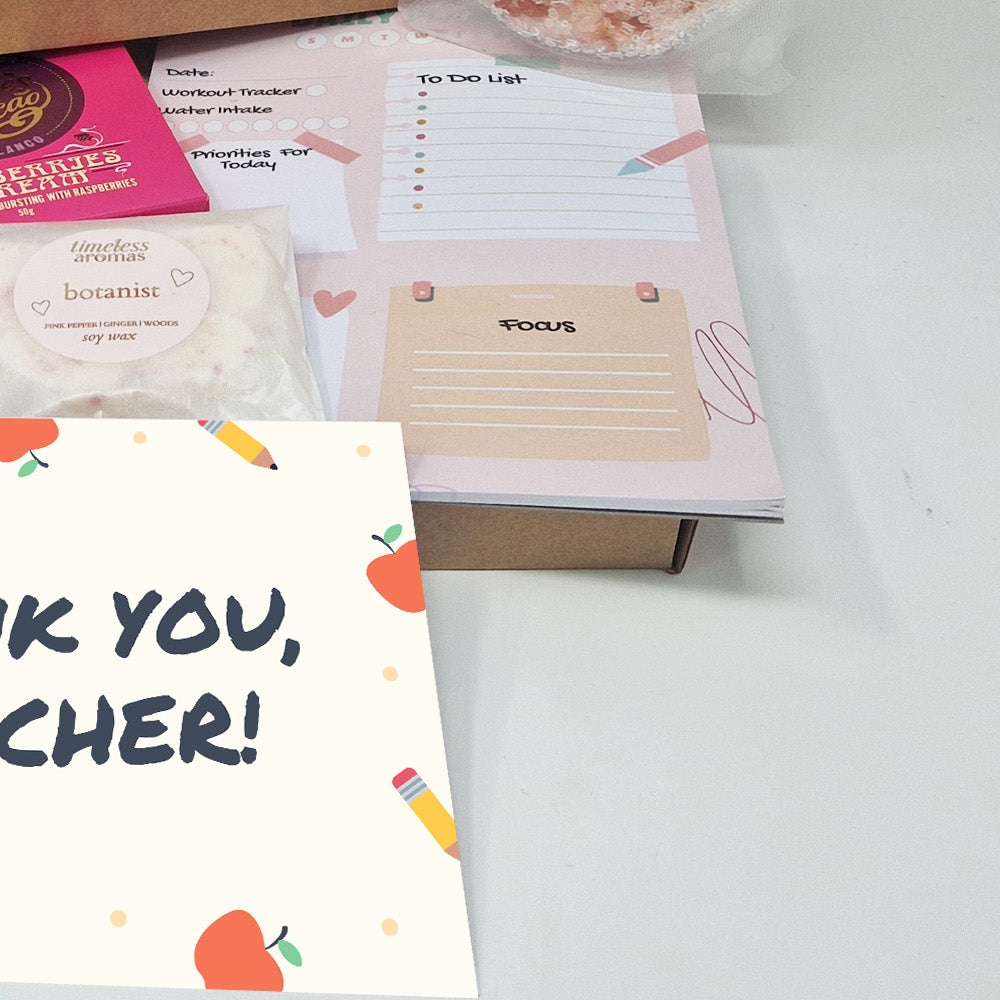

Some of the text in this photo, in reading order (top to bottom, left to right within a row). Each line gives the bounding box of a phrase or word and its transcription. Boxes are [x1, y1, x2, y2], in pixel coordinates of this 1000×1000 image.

[166, 68, 214, 77] Date:
[416, 74, 443, 84] To
[488, 73, 527, 84] List
[162, 88, 302, 97] Workout Tracker
[159, 105, 273, 115] Water Intake
[191, 147, 313, 160] Priorities For
[220, 160, 277, 171] Today
[46, 189, 72, 202] WITH
[73, 178, 138, 198] RASPBERRIES
[18, 208, 35, 217] 50g
[71, 239, 150, 253] timeless
[74, 252, 146, 262] aromas
[64, 282, 160, 300] botanist
[103, 320, 137, 328] GINGER
[82, 332, 137, 345] soy wax
[113, 587, 301, 667] YOU,
